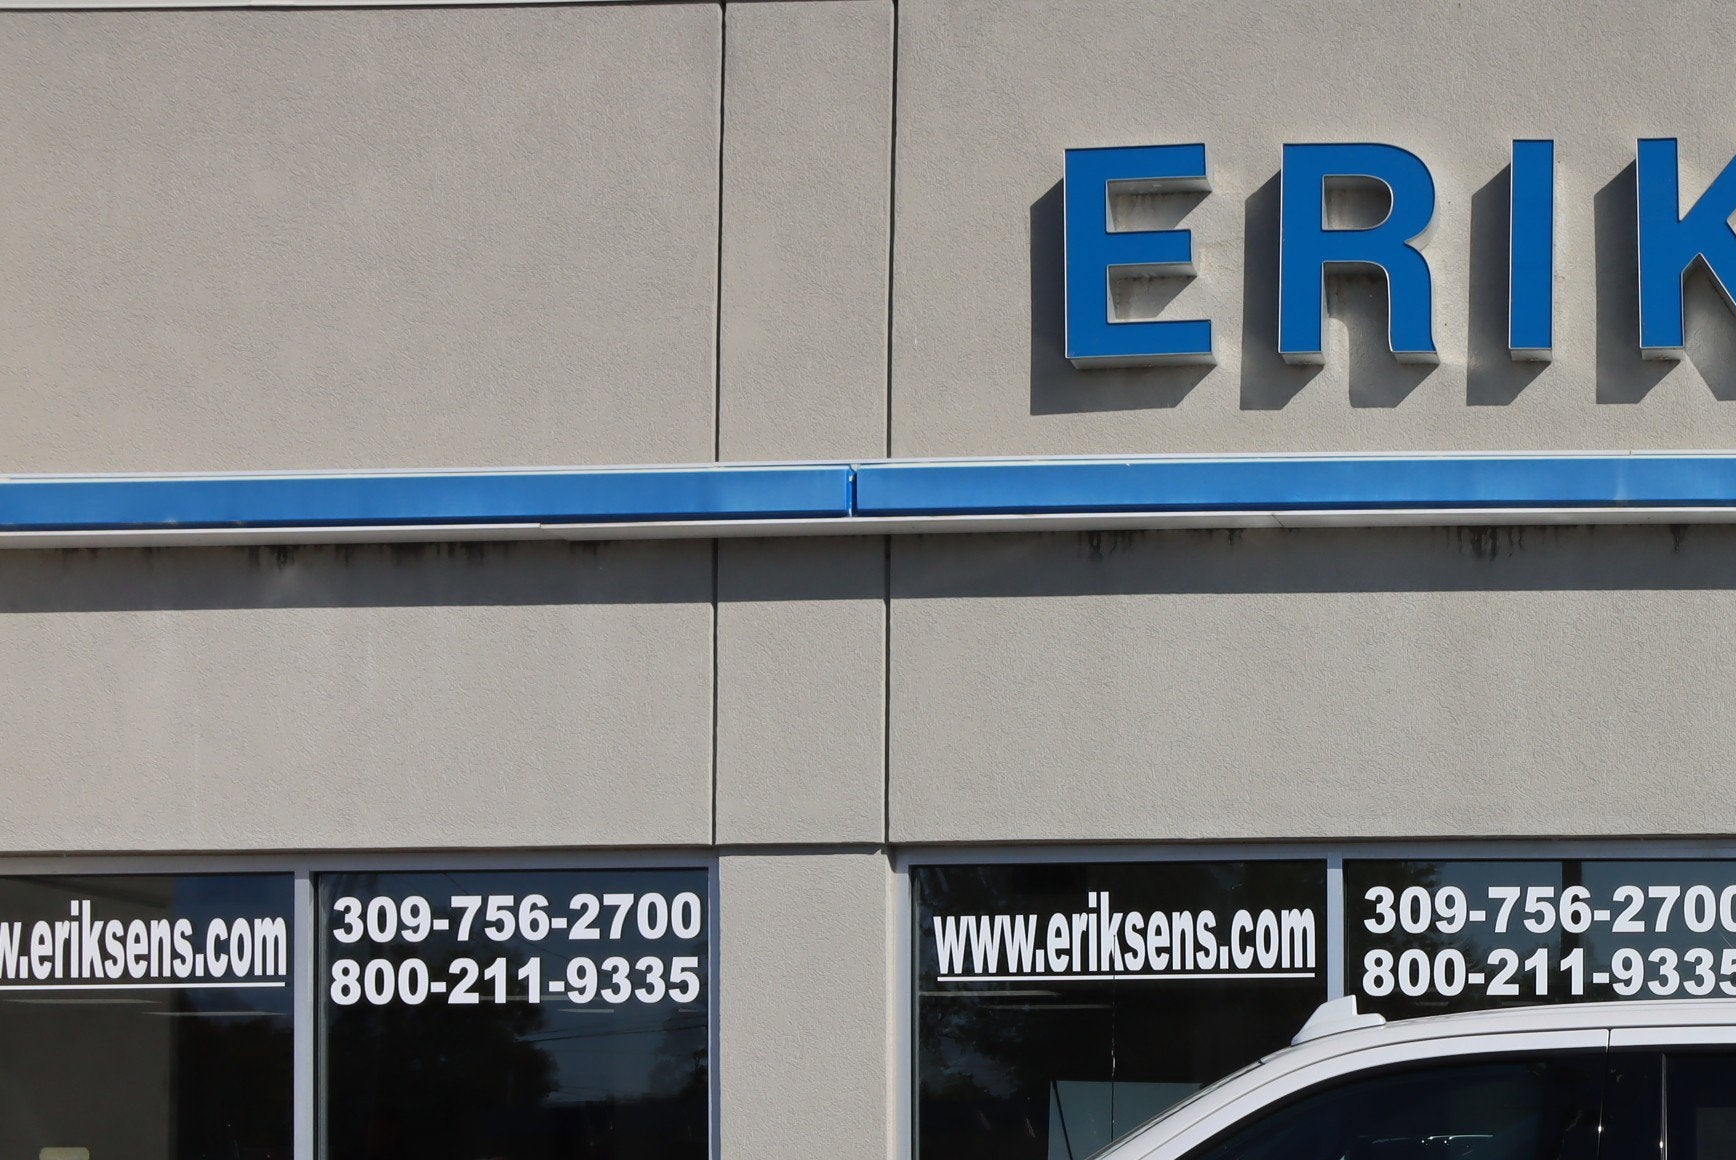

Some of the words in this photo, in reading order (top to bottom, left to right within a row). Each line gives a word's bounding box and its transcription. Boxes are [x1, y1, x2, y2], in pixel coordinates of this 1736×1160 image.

[333, 892, 701, 943] 309-756-2700
[933, 891, 1316, 974] www.eriksens.com
[330, 956, 700, 1005] 800-211-9335
